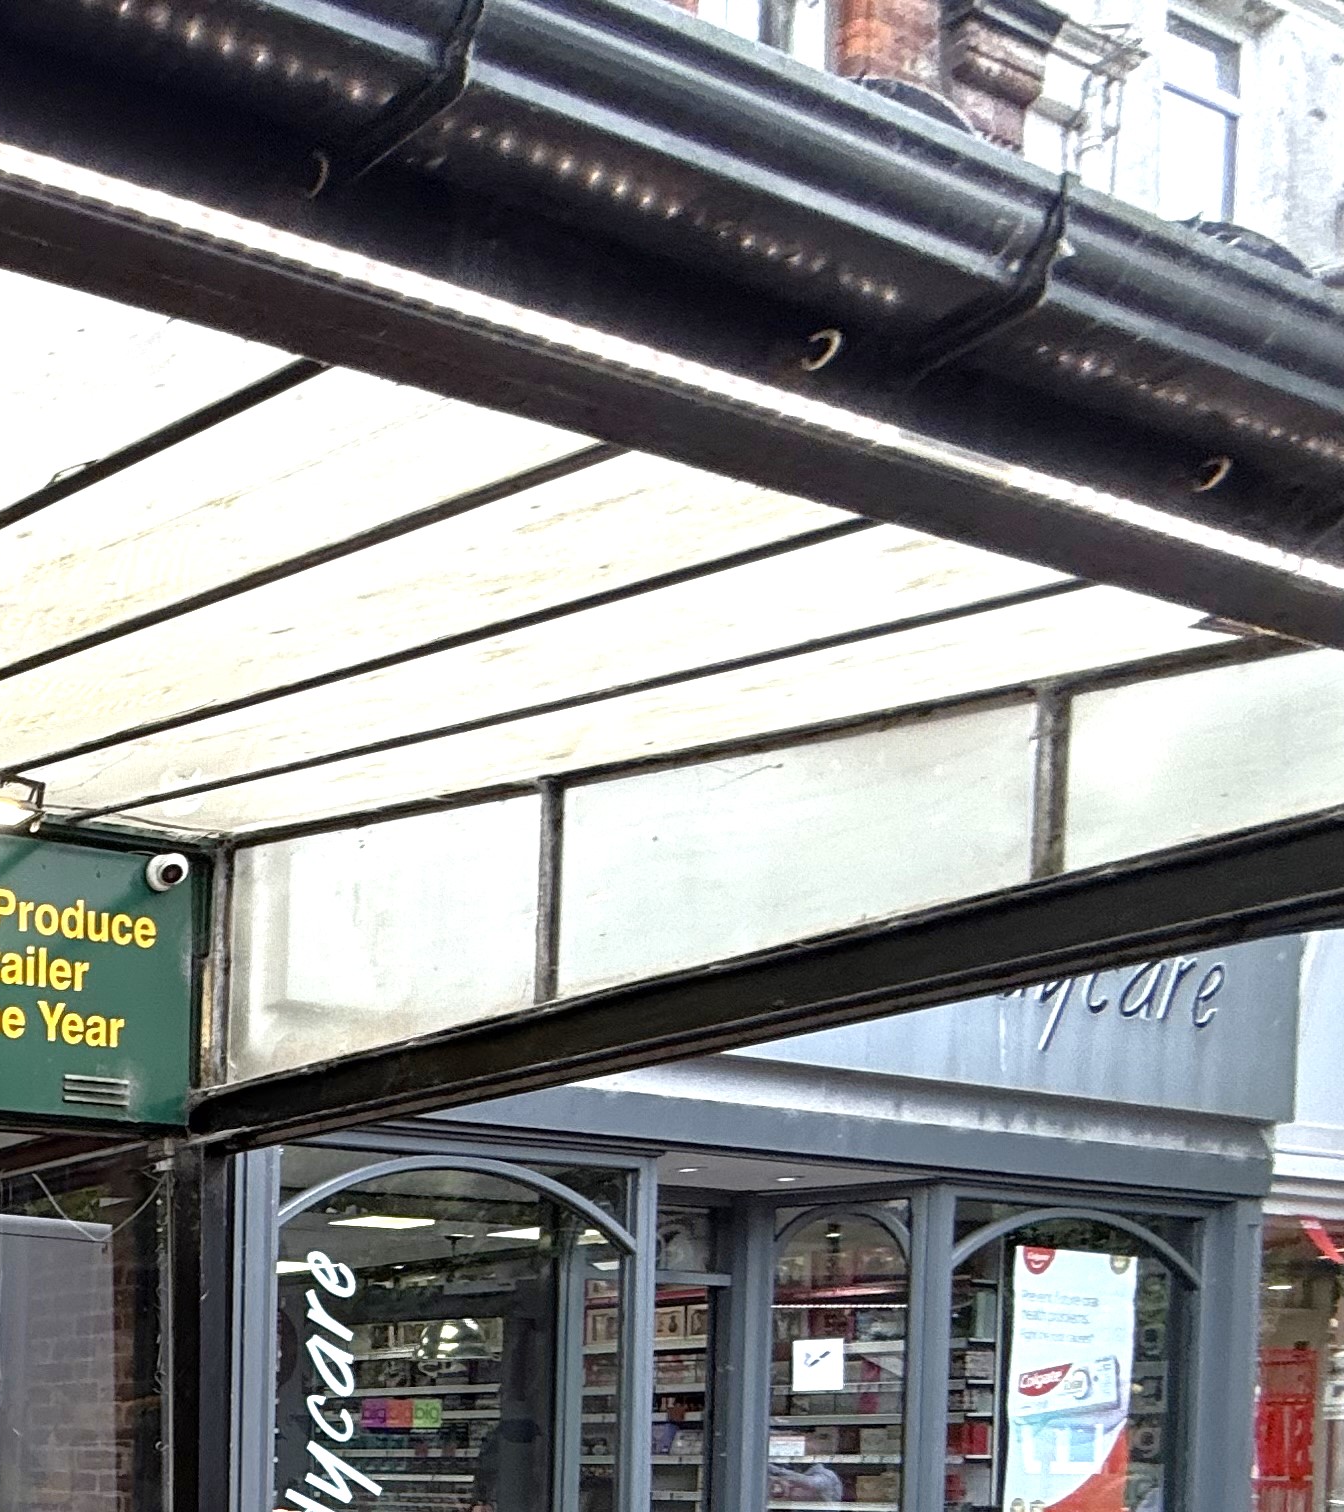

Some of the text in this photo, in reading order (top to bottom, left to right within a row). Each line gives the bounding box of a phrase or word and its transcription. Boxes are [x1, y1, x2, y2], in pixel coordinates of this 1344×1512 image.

[36, 999, 126, 1049] Year
[1019, 1371, 1063, 1389] Colgate
[415, 1403, 440, 1423] big
